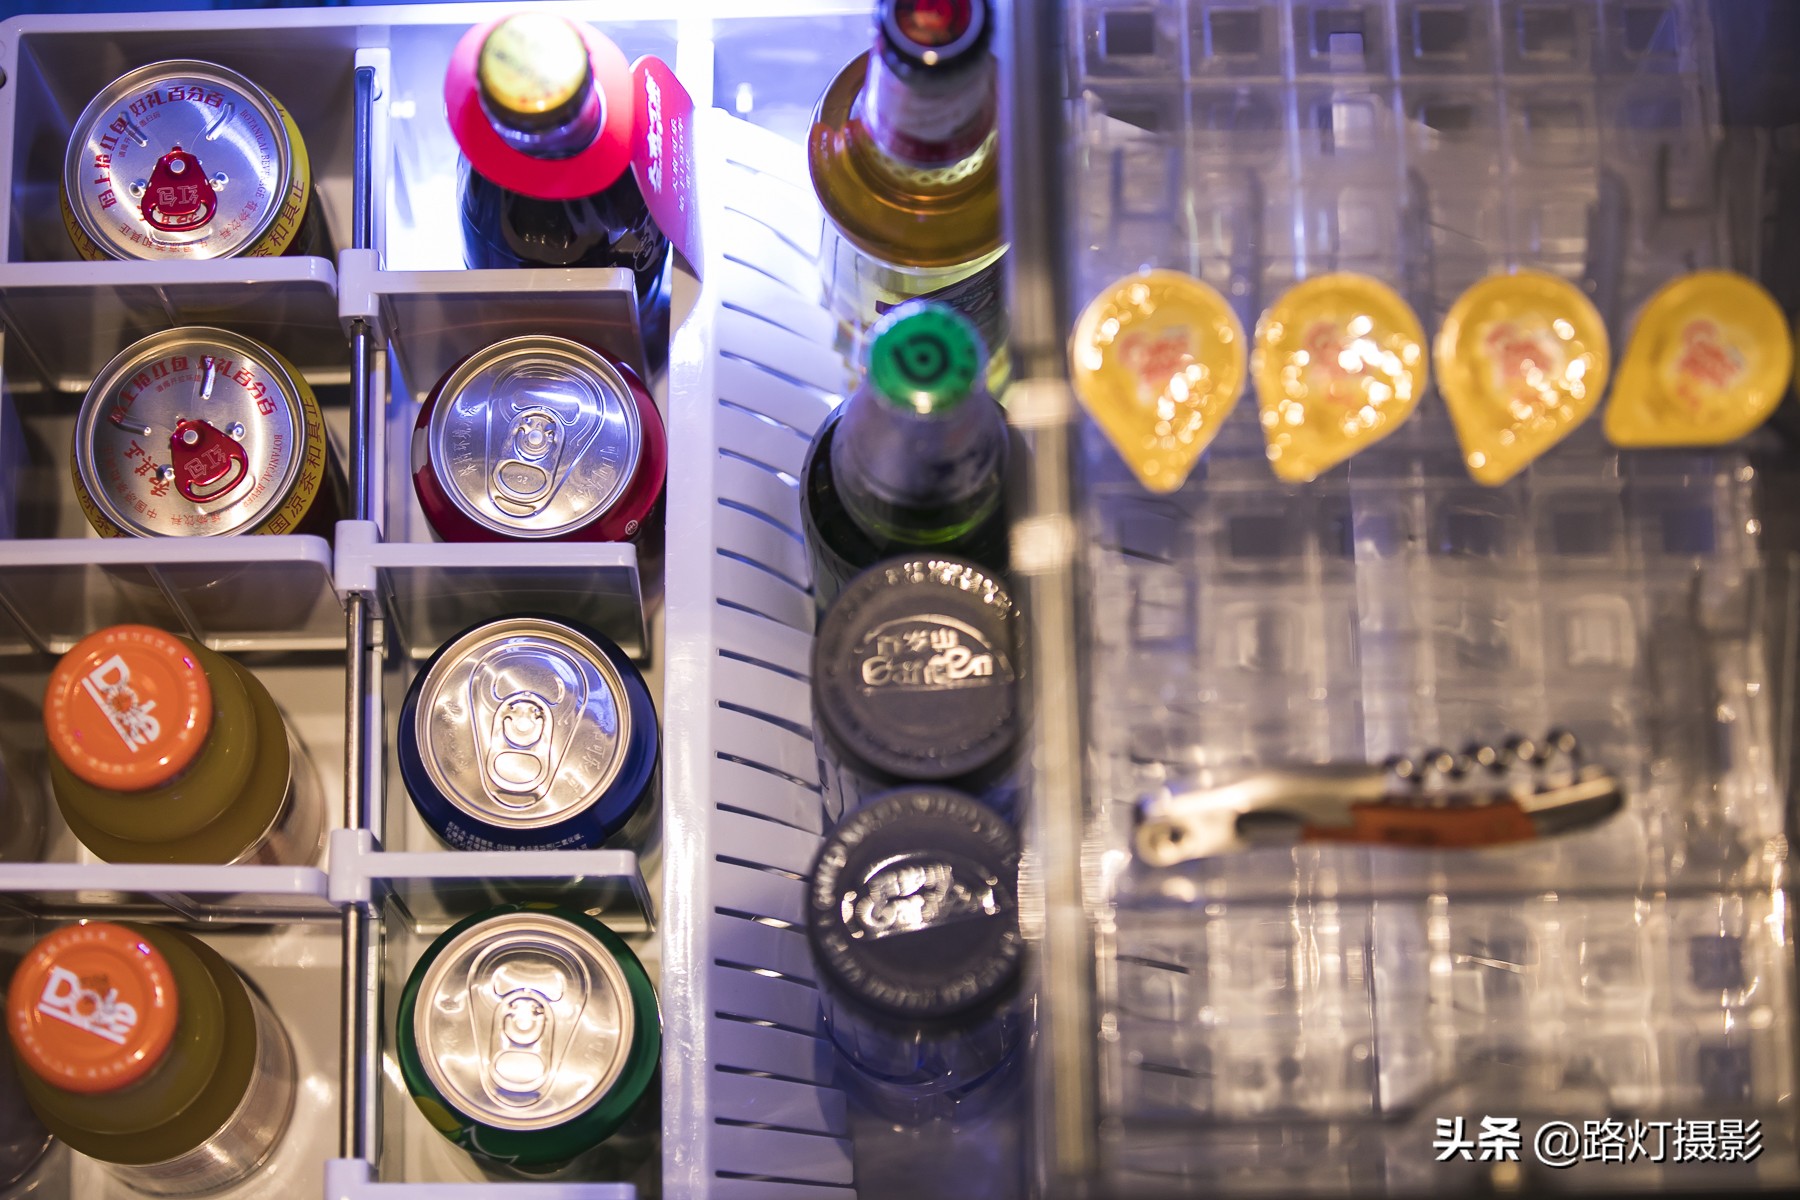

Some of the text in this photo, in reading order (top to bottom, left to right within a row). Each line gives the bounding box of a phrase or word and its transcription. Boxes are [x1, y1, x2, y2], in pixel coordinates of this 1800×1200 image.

[128, 86, 226, 118] 好礼百分百
[239, 108, 269, 152] BOTANICAL
[156, 184, 199, 207] 红包
[183, 443, 228, 480] 红包
[256, 397, 323, 537] 国凉茶和其正
[261, 433, 283, 483] BOTANICAL
[84, 654, 161, 750] Dole
[40, 966, 138, 1043] Dole
